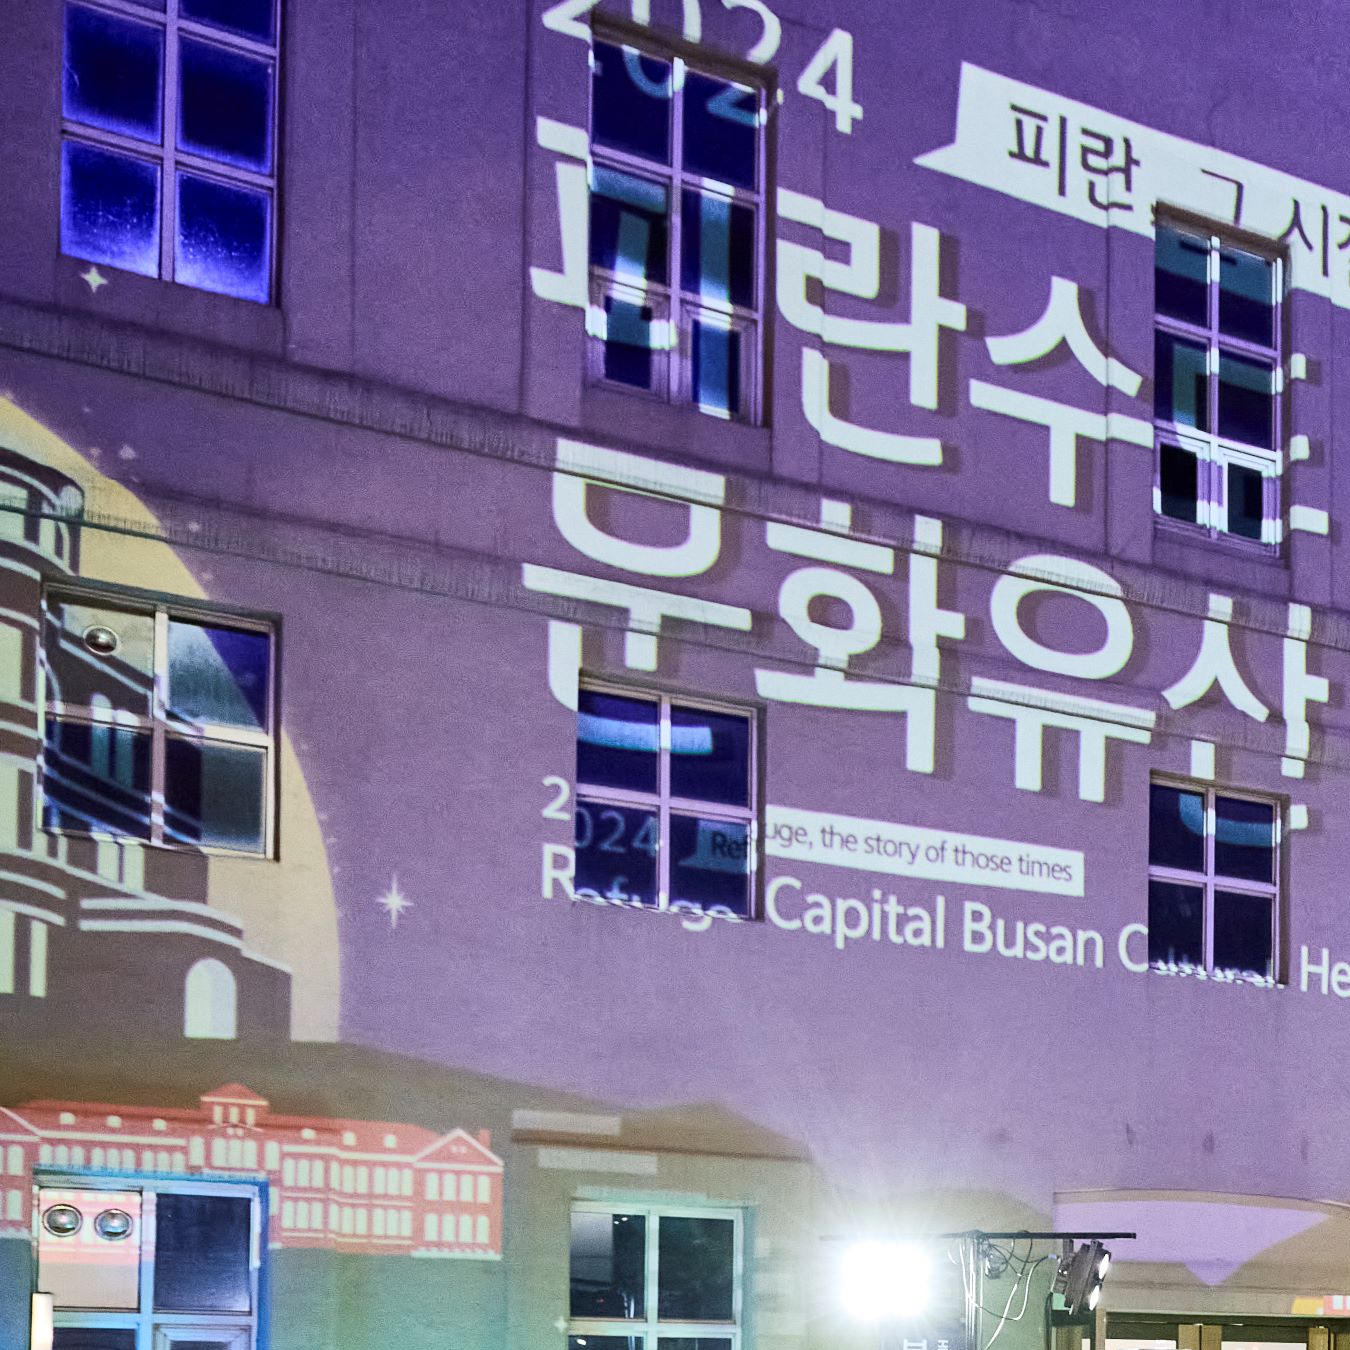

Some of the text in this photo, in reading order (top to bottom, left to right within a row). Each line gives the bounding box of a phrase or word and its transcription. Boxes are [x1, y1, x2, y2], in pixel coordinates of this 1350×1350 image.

[1006, 102, 1140, 213] 피란
[521, 438, 1329, 845] 문화유산
[820, 824, 859, 852] the
[863, 833, 921, 865] story
[924, 839, 949, 864] of
[952, 843, 1012, 873] those
[1017, 853, 1073, 883] times
[765, 877, 945, 951] Capital
[963, 900, 1104, 969] Busan
